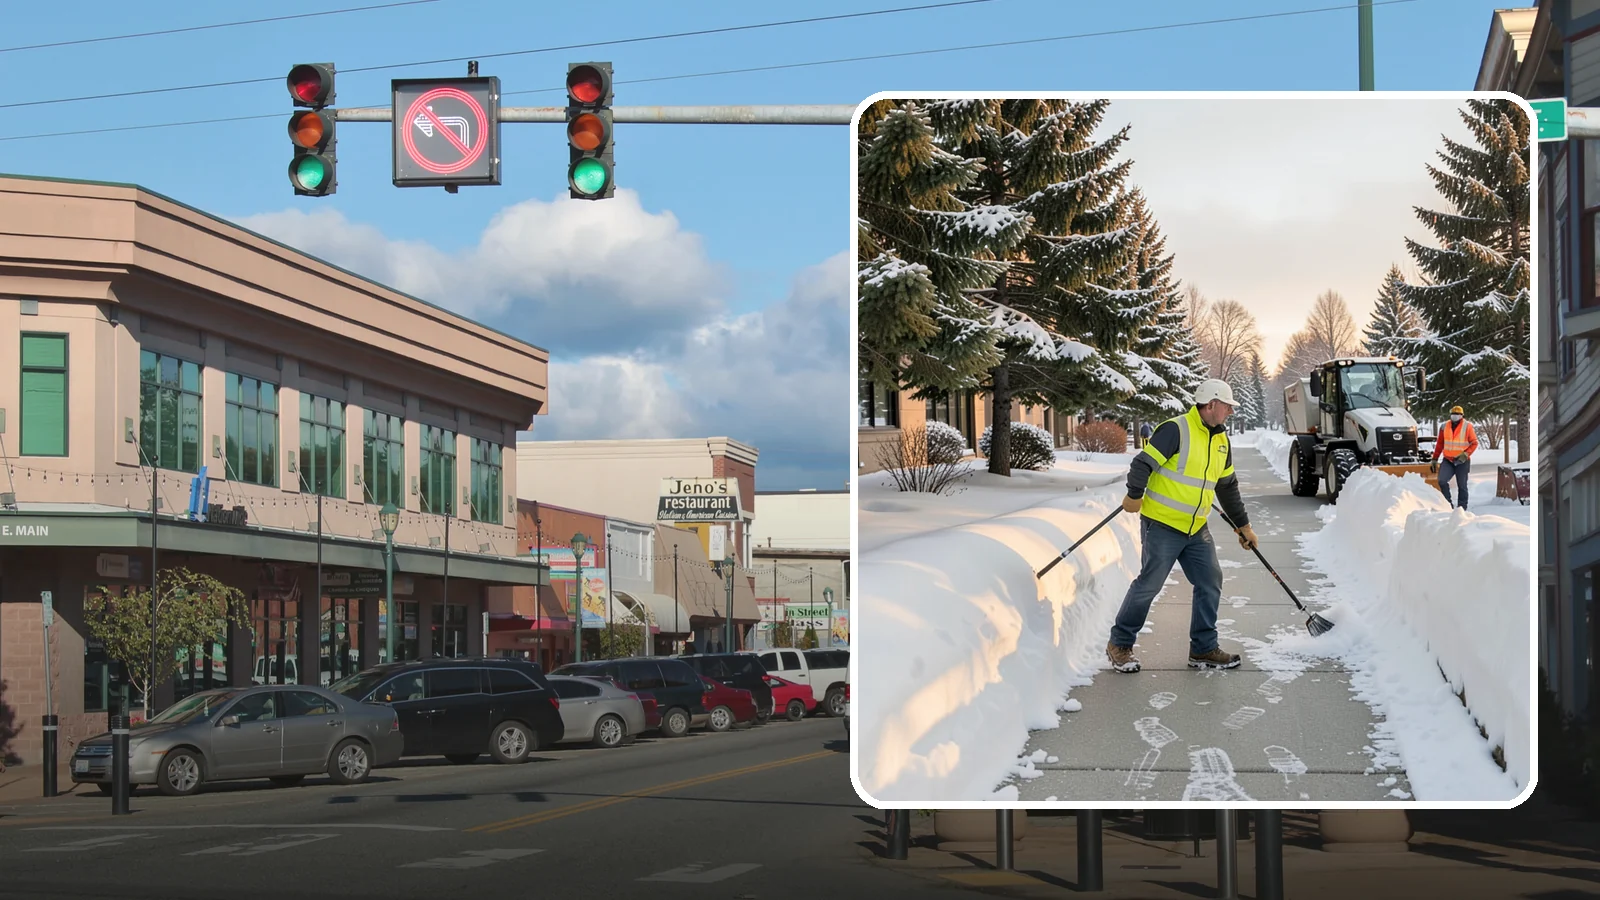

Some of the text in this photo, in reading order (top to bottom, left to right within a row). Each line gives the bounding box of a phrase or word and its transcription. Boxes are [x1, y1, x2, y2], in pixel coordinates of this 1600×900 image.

[669, 479, 728, 495] Jeno's
[665, 496, 731, 509] restaurant
[658, 509, 682, 520] Italian
[686, 509, 714, 520] American
[715, 509, 738, 519] Cuisine
[2, 525, 49, 536] E. MAIN
[785, 607, 829, 617] in Street
[791, 619, 824, 628] lass
